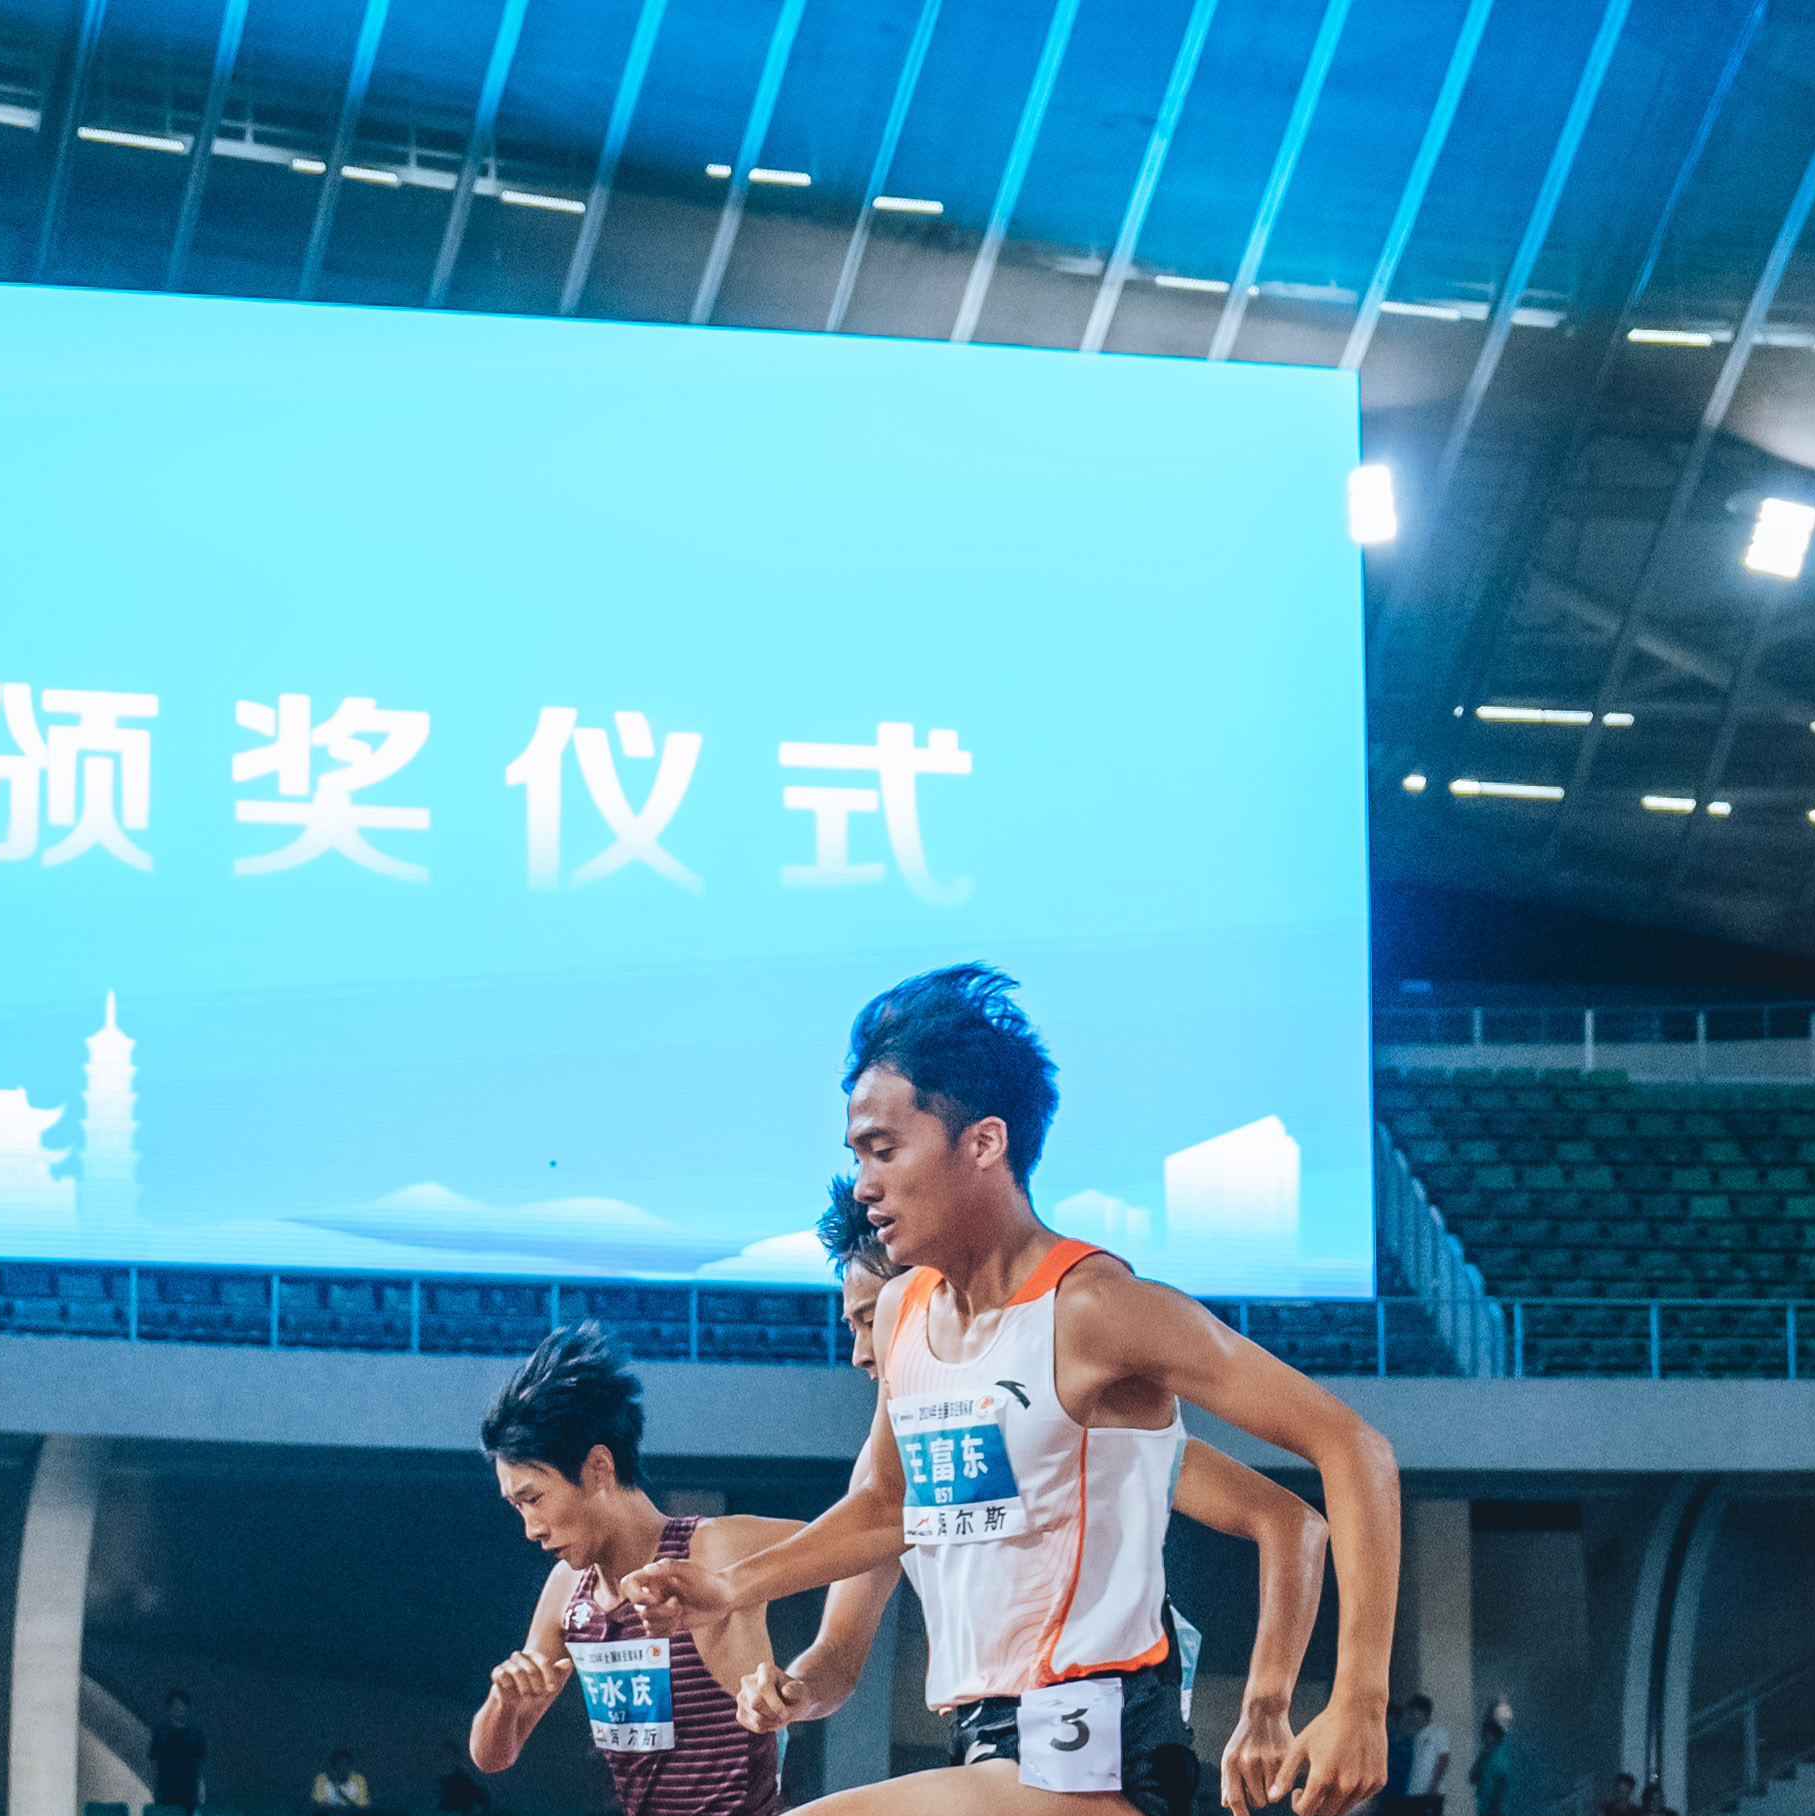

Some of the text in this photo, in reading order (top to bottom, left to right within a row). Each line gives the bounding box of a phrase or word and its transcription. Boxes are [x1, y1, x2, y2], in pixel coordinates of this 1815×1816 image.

[904, 1433, 989, 1484] 王富东
[1050, 1708, 1090, 1752] 3
